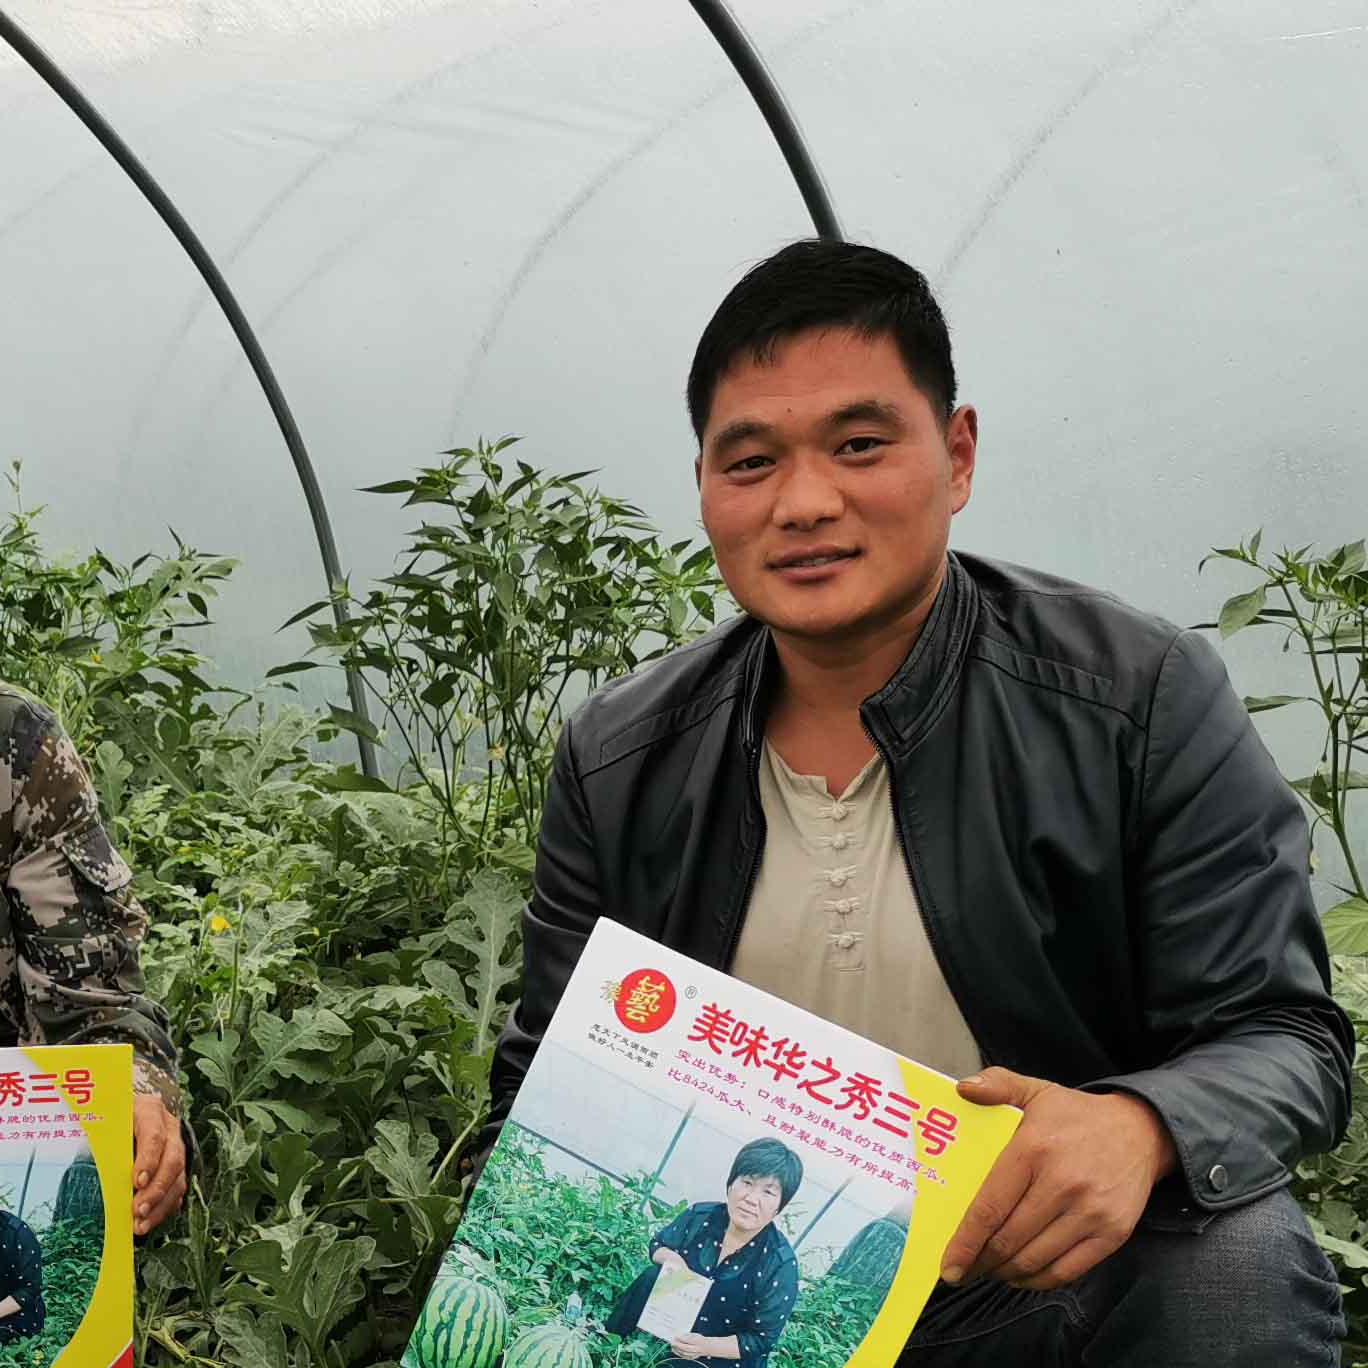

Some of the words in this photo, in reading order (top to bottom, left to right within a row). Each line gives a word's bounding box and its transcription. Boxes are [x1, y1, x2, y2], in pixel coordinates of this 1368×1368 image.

[687, 1002, 959, 1156] 美味华之秀三号
